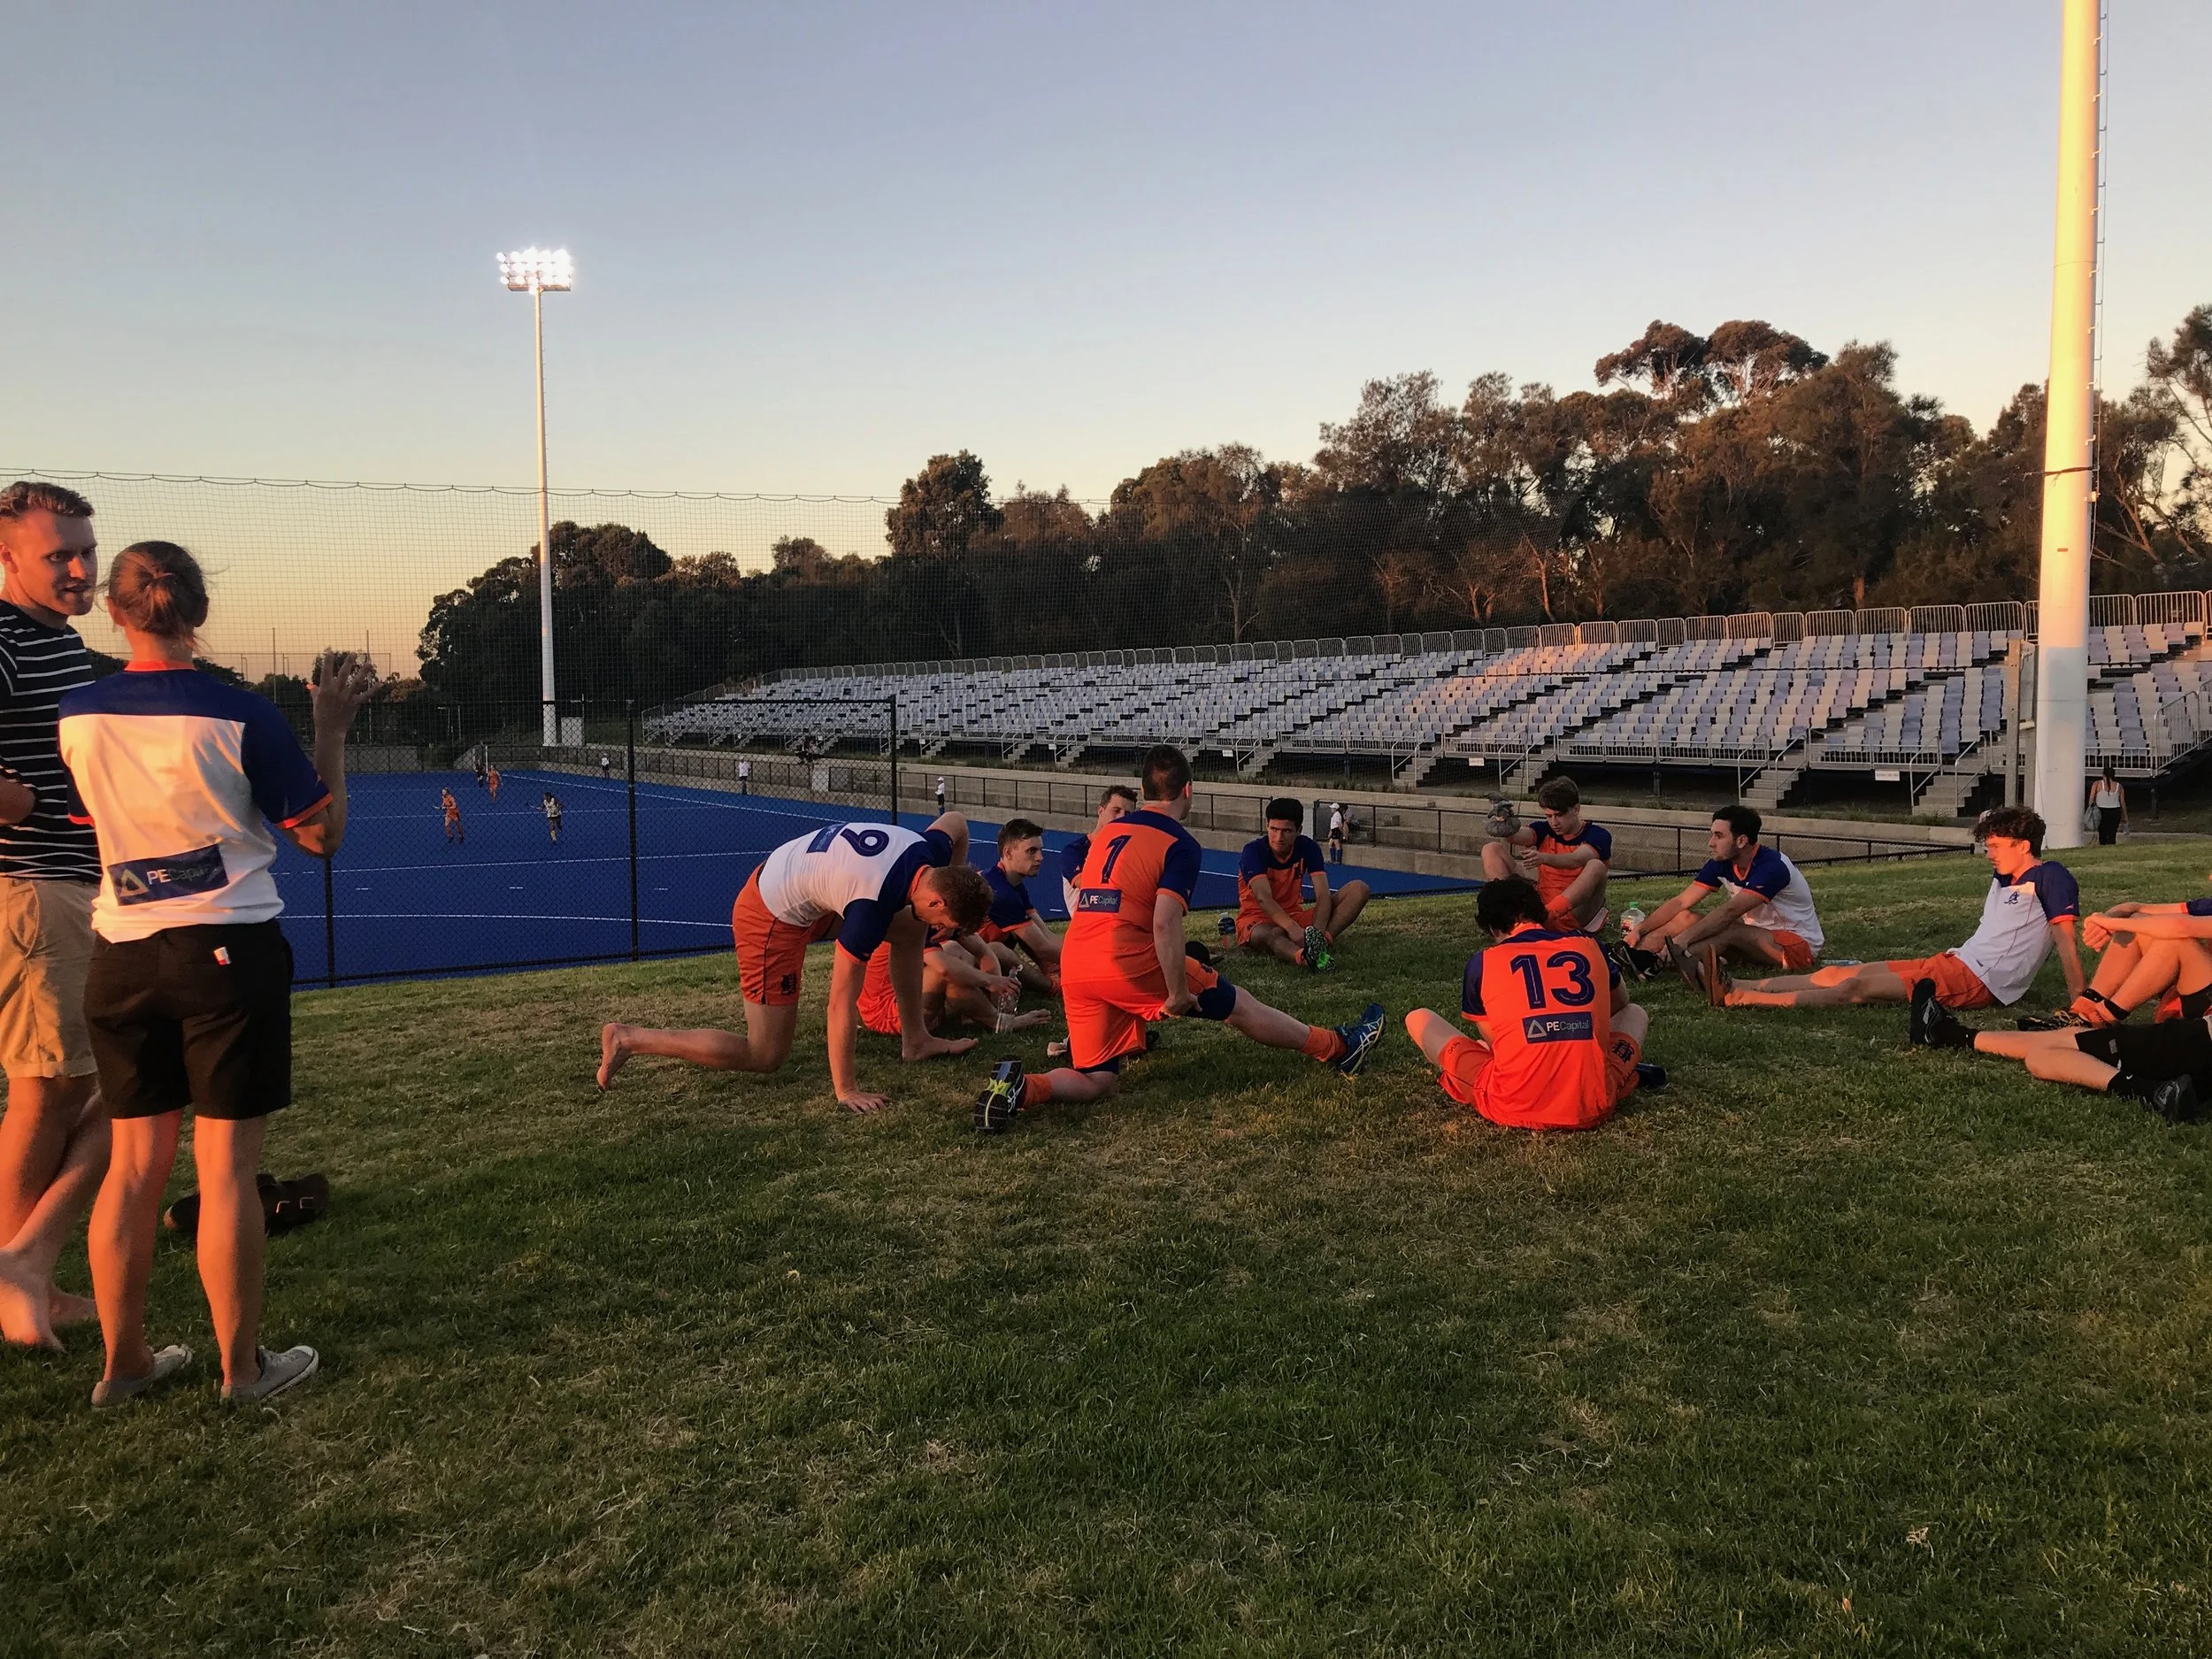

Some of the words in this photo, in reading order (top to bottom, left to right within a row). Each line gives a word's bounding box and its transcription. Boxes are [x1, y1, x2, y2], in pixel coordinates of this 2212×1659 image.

[146, 864, 216, 886] PECapit
[1101, 834, 1133, 884] 1
[1509, 951, 1595, 1010] 13
